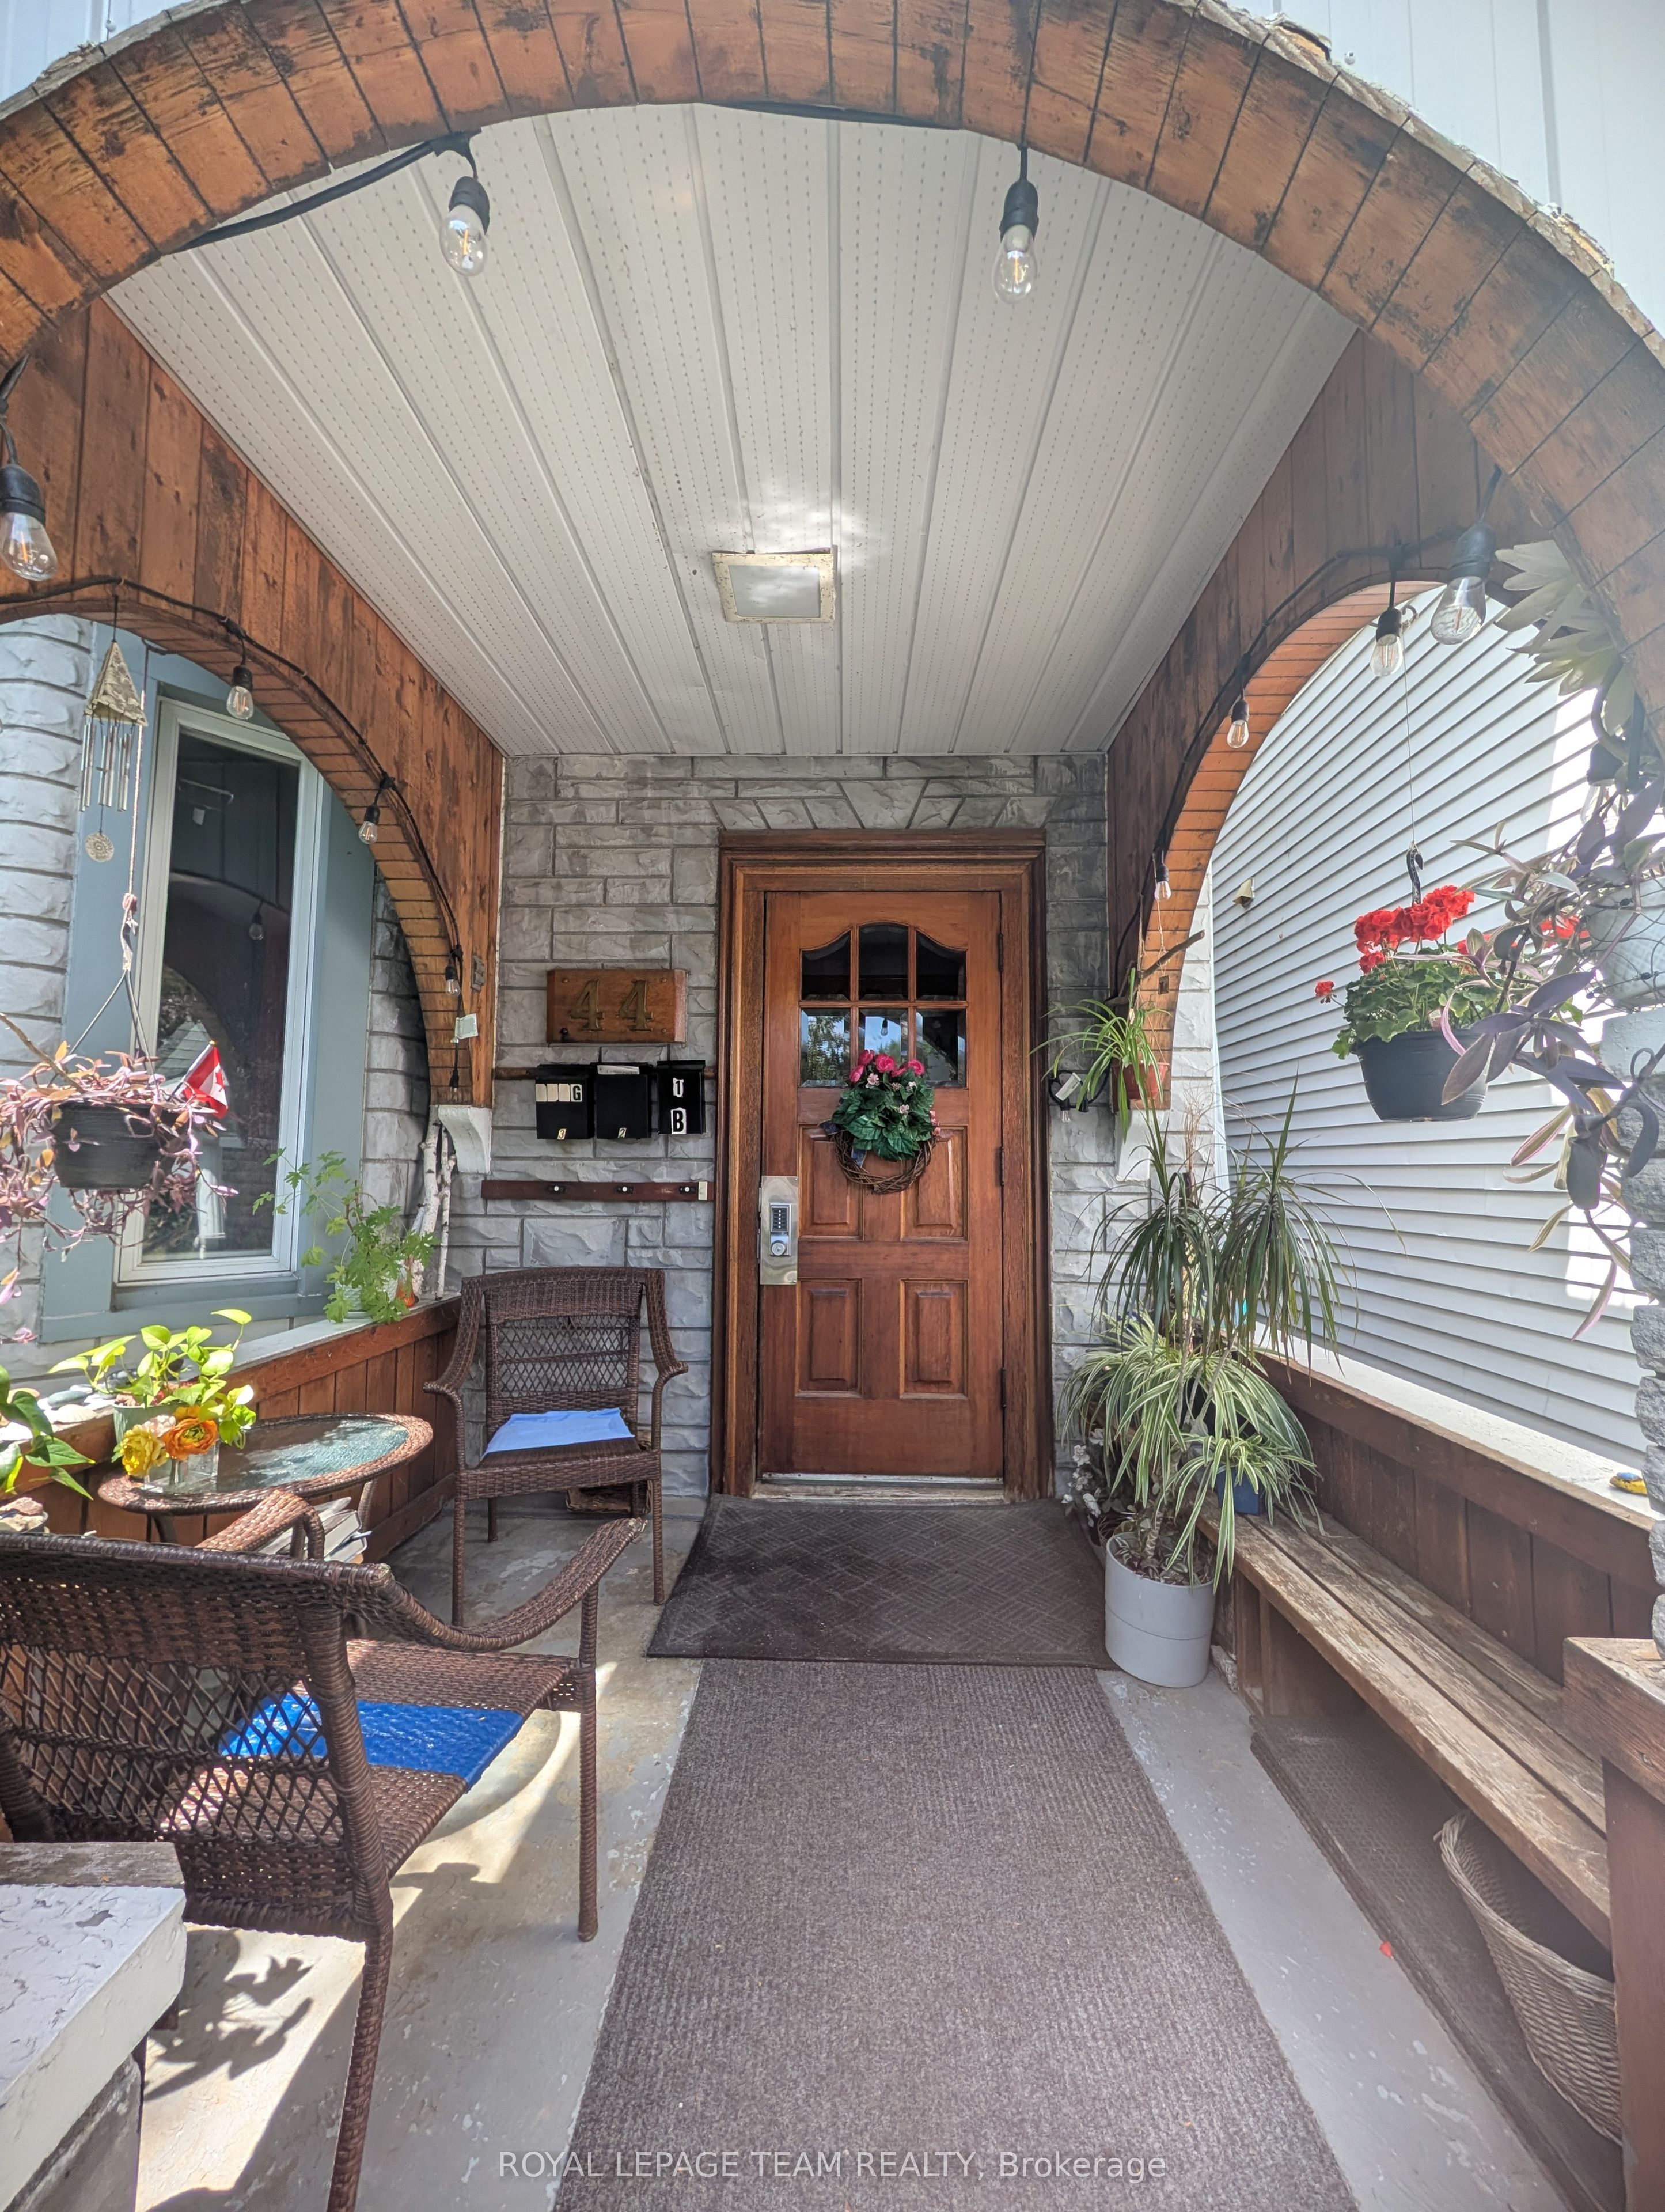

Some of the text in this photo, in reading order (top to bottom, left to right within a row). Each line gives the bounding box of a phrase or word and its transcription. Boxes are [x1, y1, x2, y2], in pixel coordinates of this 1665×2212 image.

[568, 979, 653, 1032] 44
[572, 1085, 581, 1101] G
[672, 1109, 684, 1132] B
[559, 1129, 564, 1139] 3
[619, 1128, 625, 1138] 2
